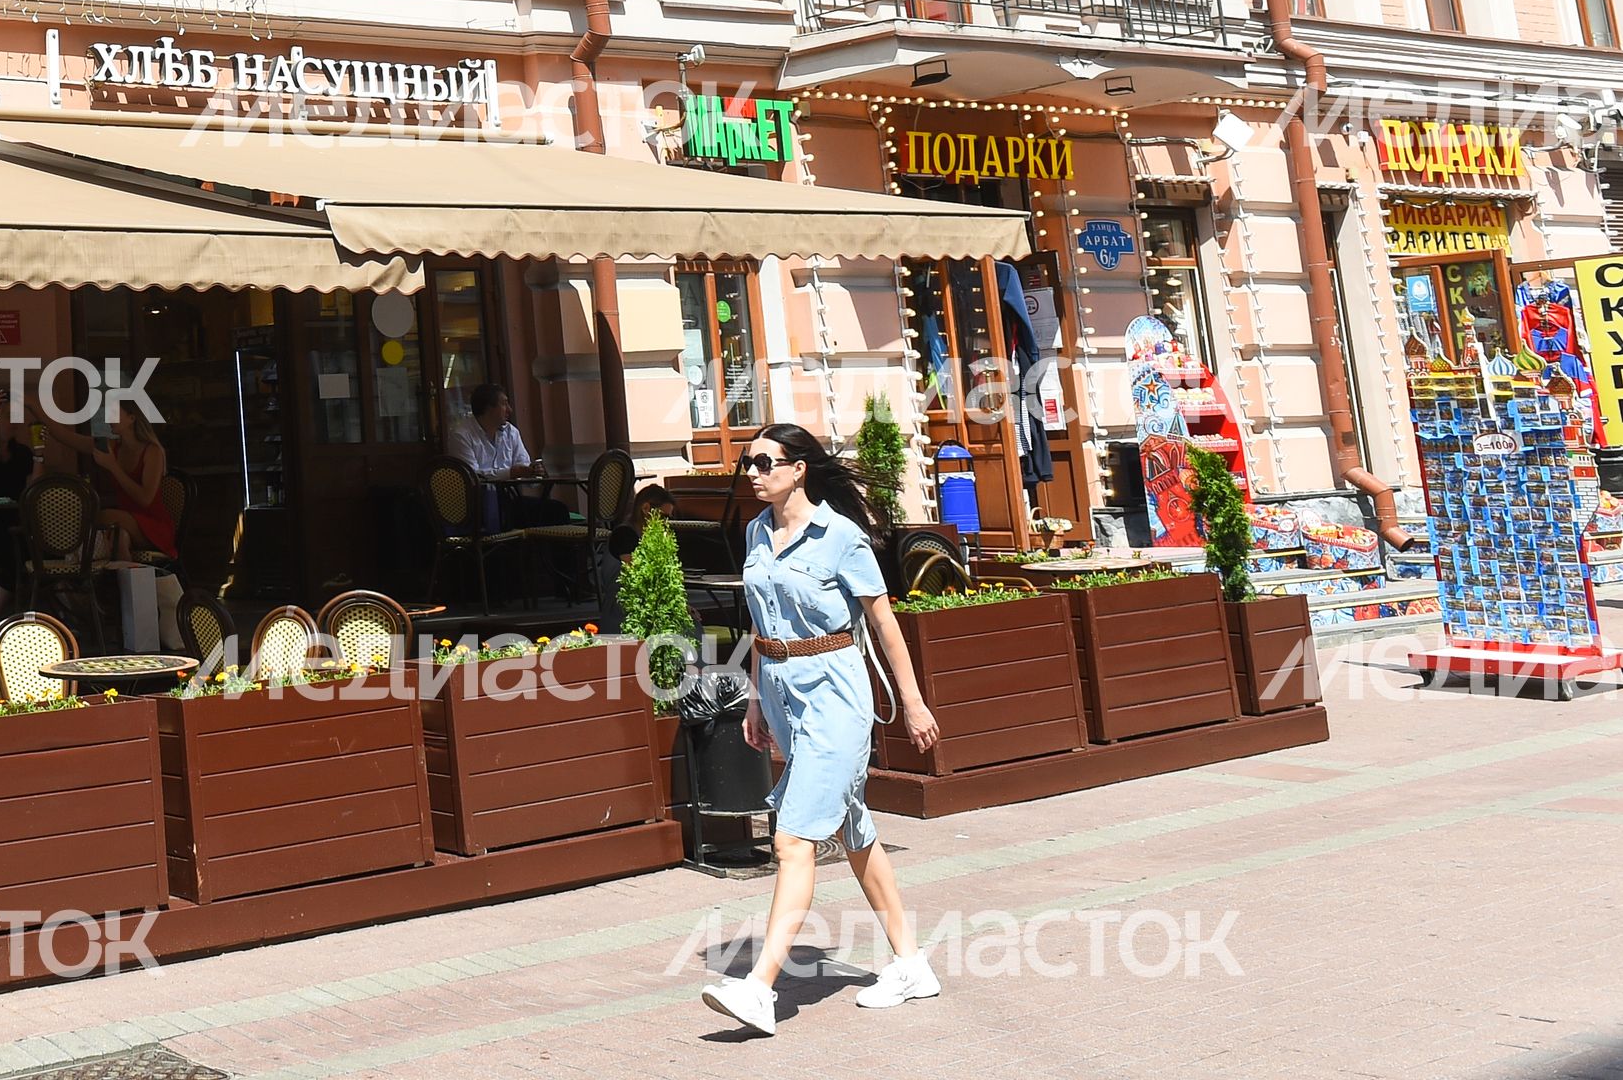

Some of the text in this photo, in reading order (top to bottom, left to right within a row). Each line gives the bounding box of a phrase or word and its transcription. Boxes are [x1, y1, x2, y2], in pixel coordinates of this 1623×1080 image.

[234, 52, 490, 105] НАСУЩНЫЙ
[906, 130, 1075, 185] ПОДАРКИ
[1379, 119, 1525, 183] ПОДАРКИ
[1084, 235, 1126, 247] АРБАТ
[1091, 224, 1117, 233] УЛИЦА
[1099, 248, 1116, 268] 6/2
